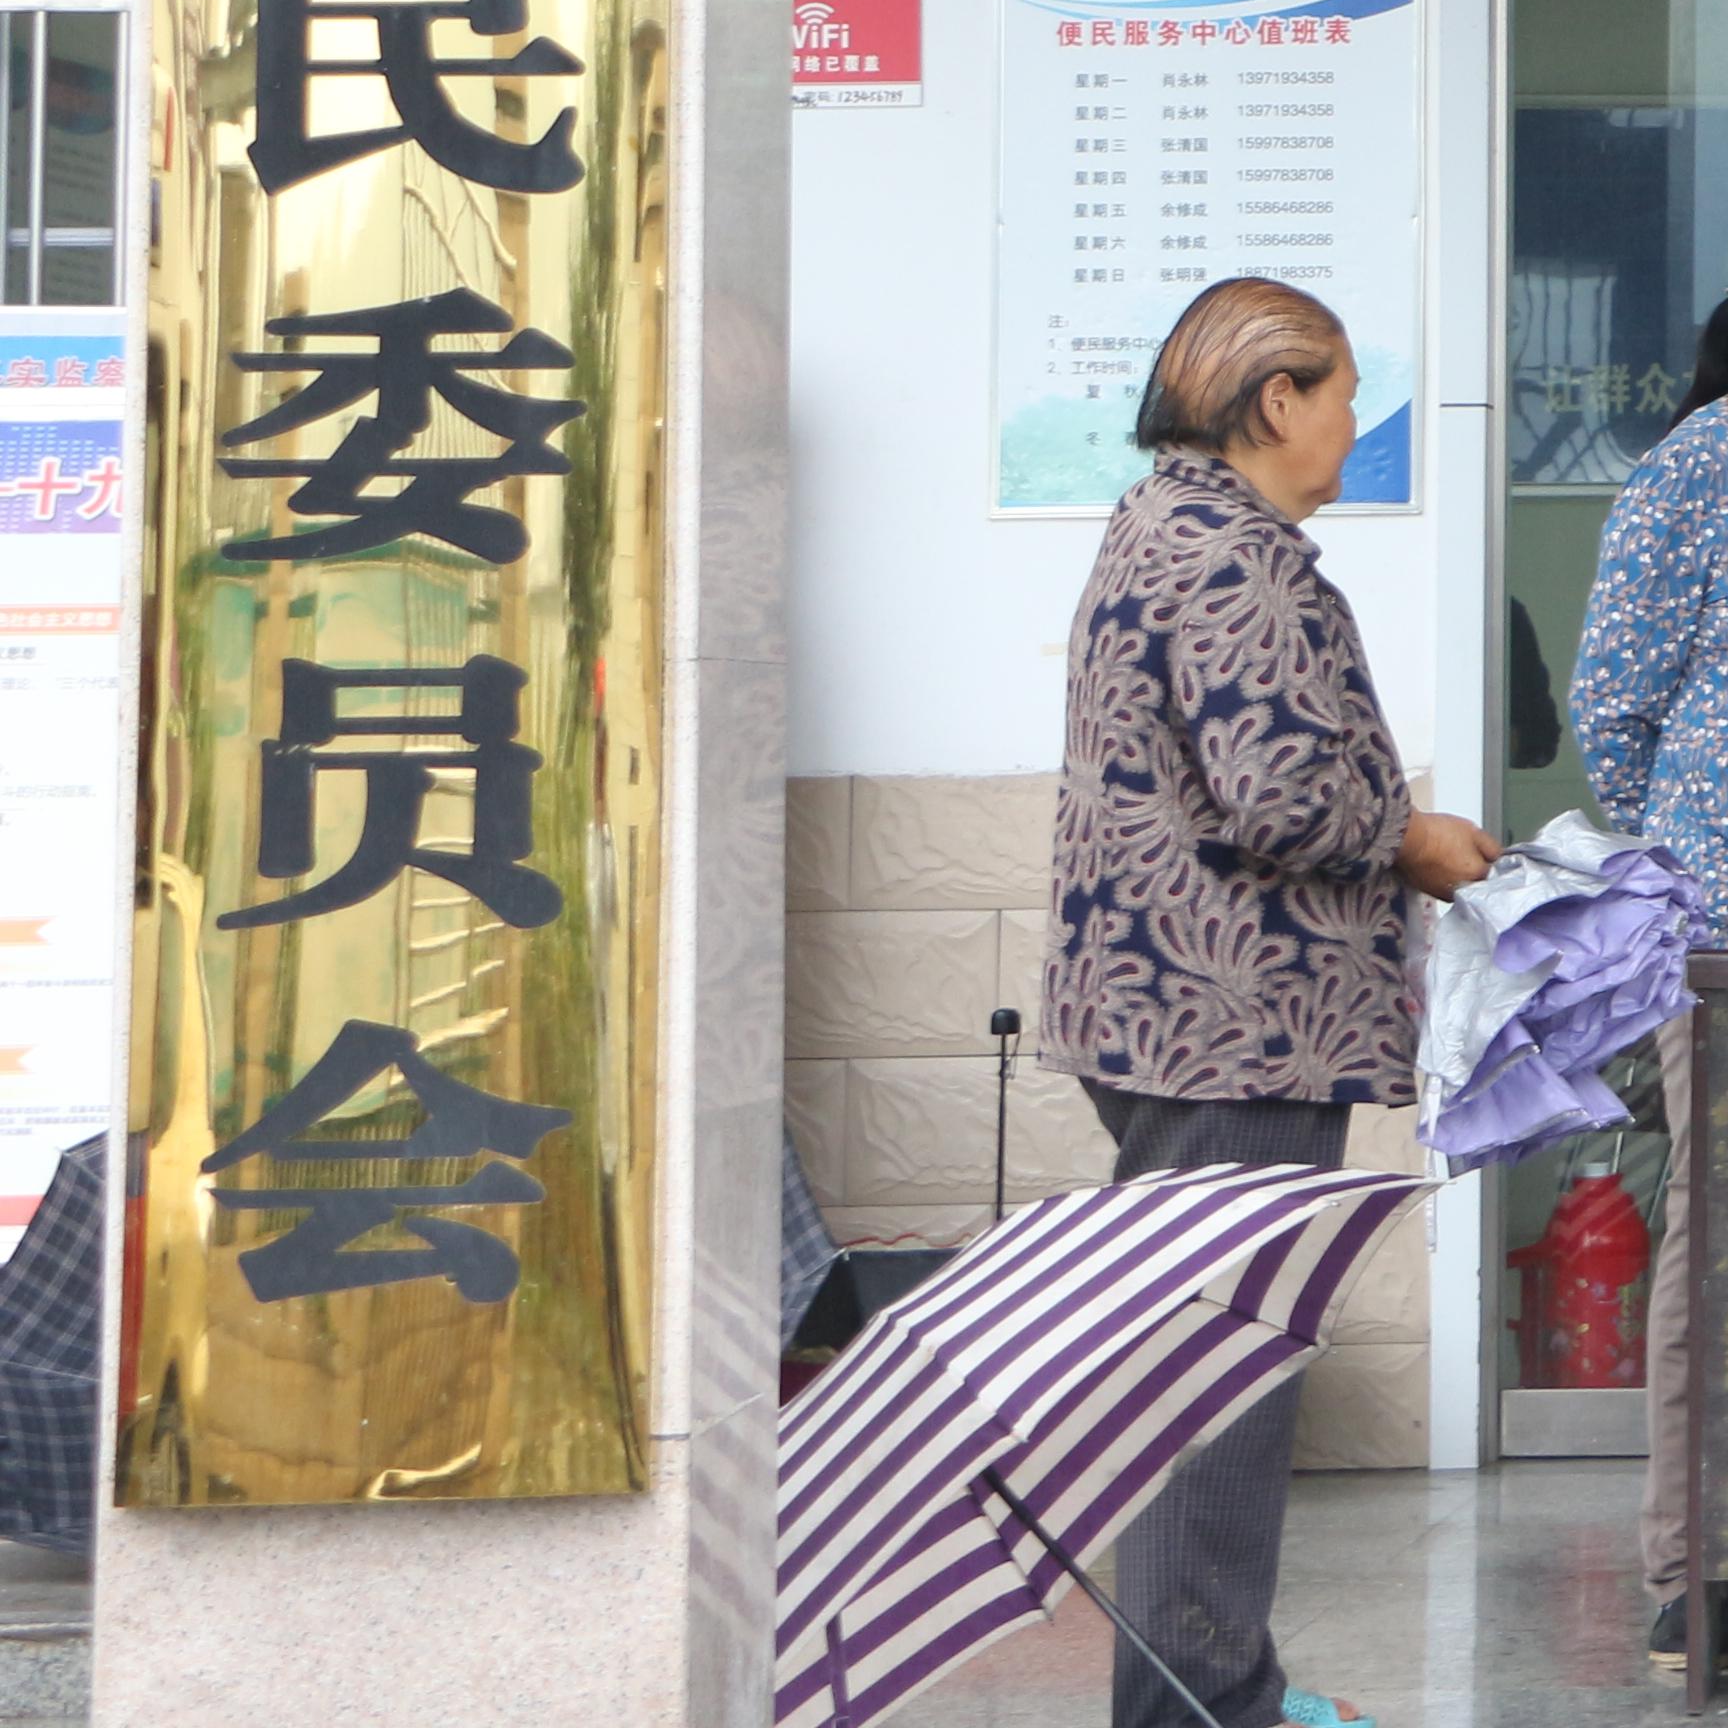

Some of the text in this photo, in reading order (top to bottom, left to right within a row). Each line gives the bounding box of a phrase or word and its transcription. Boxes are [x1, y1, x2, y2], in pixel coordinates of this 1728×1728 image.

[1056, 18, 1352, 47] 便民服务中心值班表
[1074, 73, 1128, 88] 星期一
[1074, 105, 1128, 120] 星期二
[1074, 138, 1128, 153] 星期三
[1074, 171, 1128, 186] 星期四
[1074, 203, 1128, 218] 星期五
[1074, 236, 1128, 251] 星期六
[1074, 268, 1128, 283] 星期日
